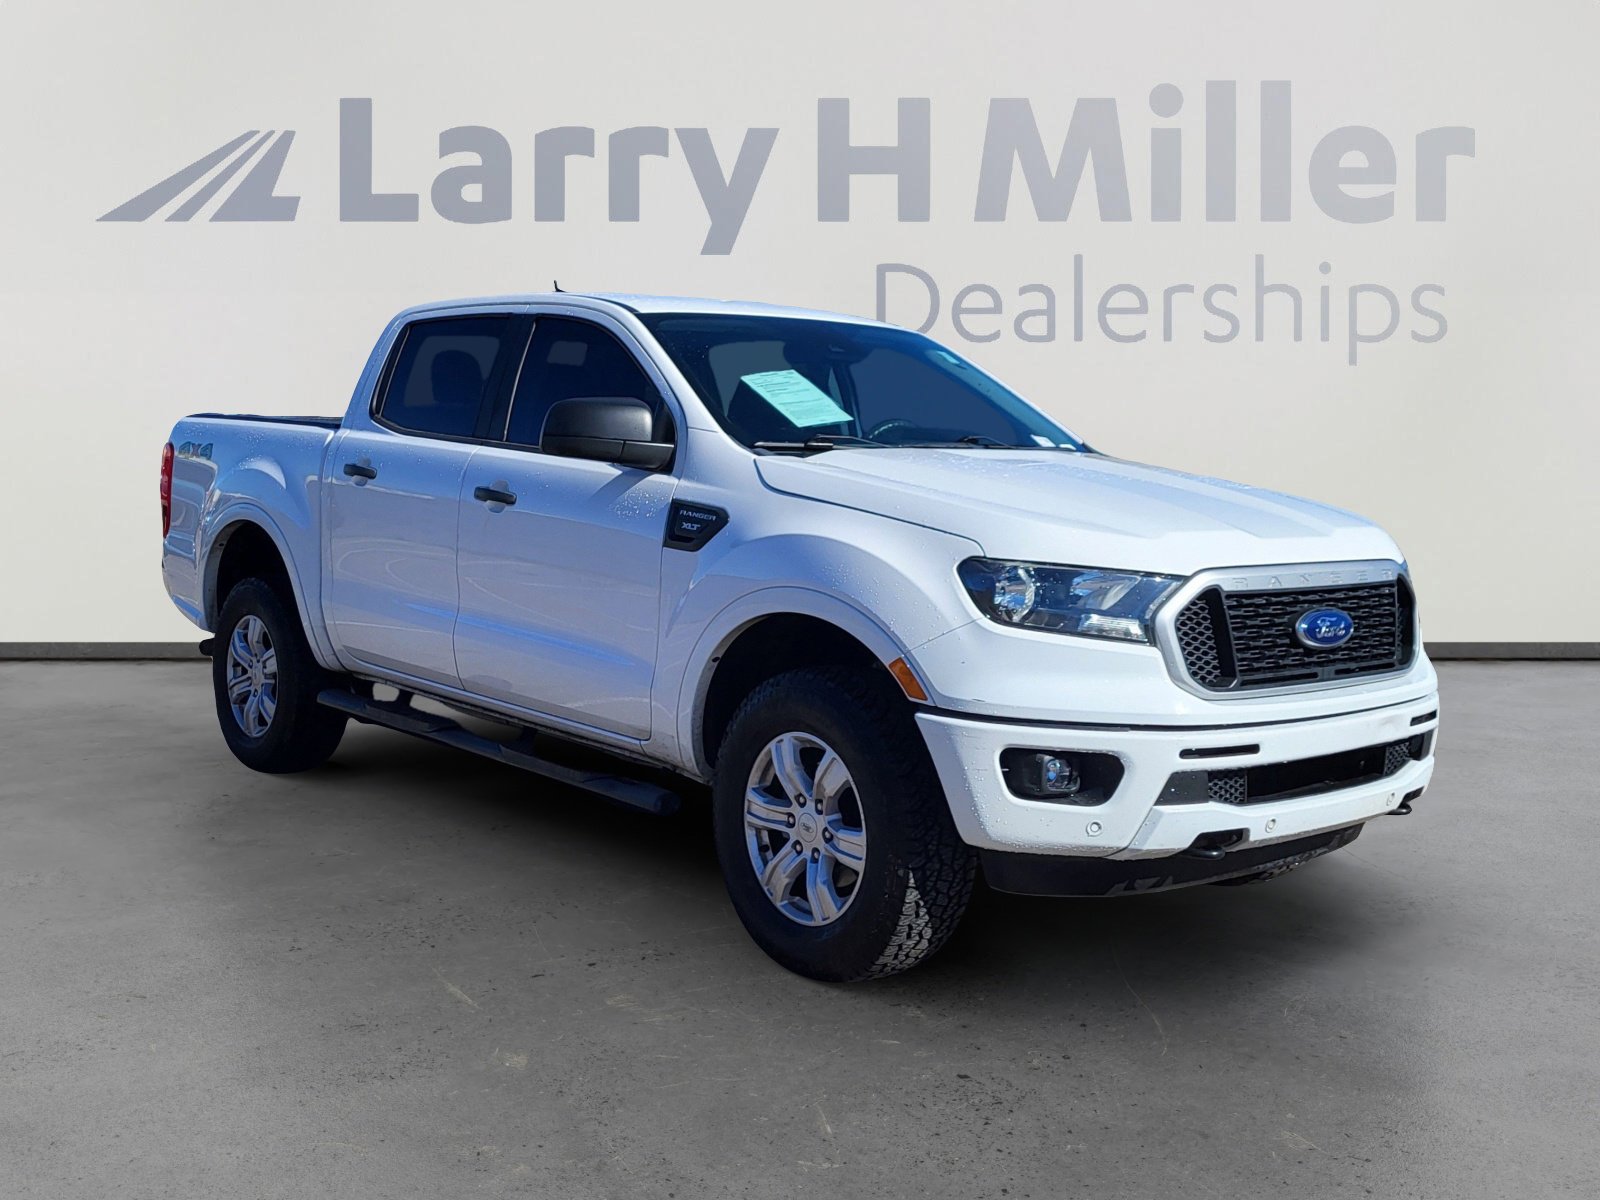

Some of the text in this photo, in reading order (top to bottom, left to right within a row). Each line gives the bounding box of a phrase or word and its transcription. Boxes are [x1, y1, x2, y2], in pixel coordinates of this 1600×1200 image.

[339, 80, 1476, 256] Larry H Miller
[875, 253, 1448, 367] Dealerships
[679, 509, 717, 521] RANGER
[681, 521, 701, 531] XLT
[1232, 568, 1394, 589] RANGER
[1315, 616, 1348, 639] Ford
